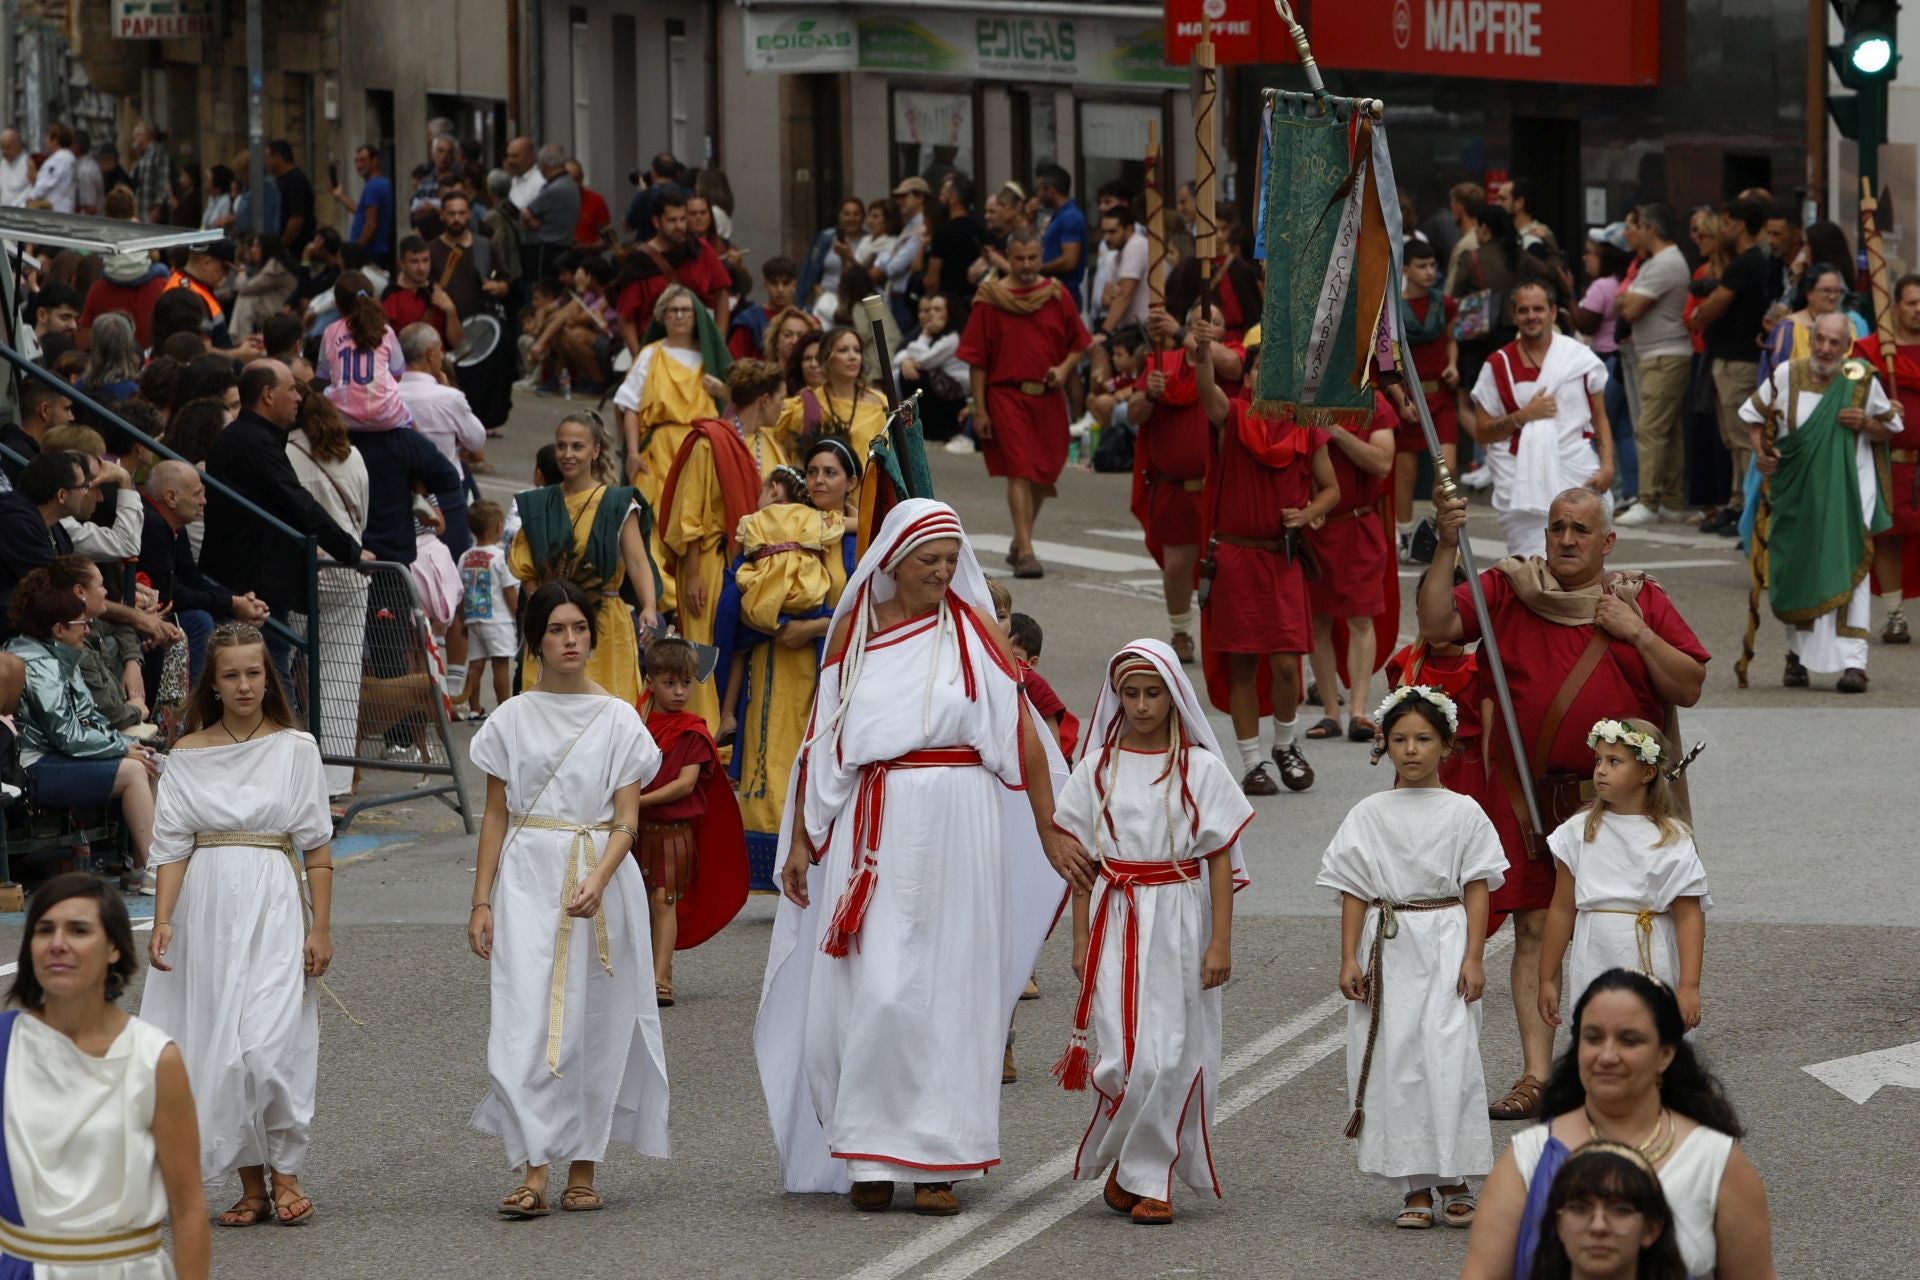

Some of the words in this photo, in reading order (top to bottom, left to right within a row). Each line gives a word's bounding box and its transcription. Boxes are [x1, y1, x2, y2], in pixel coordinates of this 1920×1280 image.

[121, 17, 216, 35] PAPELERIA
[756, 32, 851, 49] EDIGAS
[976, 18, 1077, 62] EDIGAS
[1425, 0, 1542, 57] MAPFRE
[1341, 163, 1366, 248] UERRAS
[1311, 255, 1348, 380] CANTABRAS
[338, 347, 374, 385] 10
